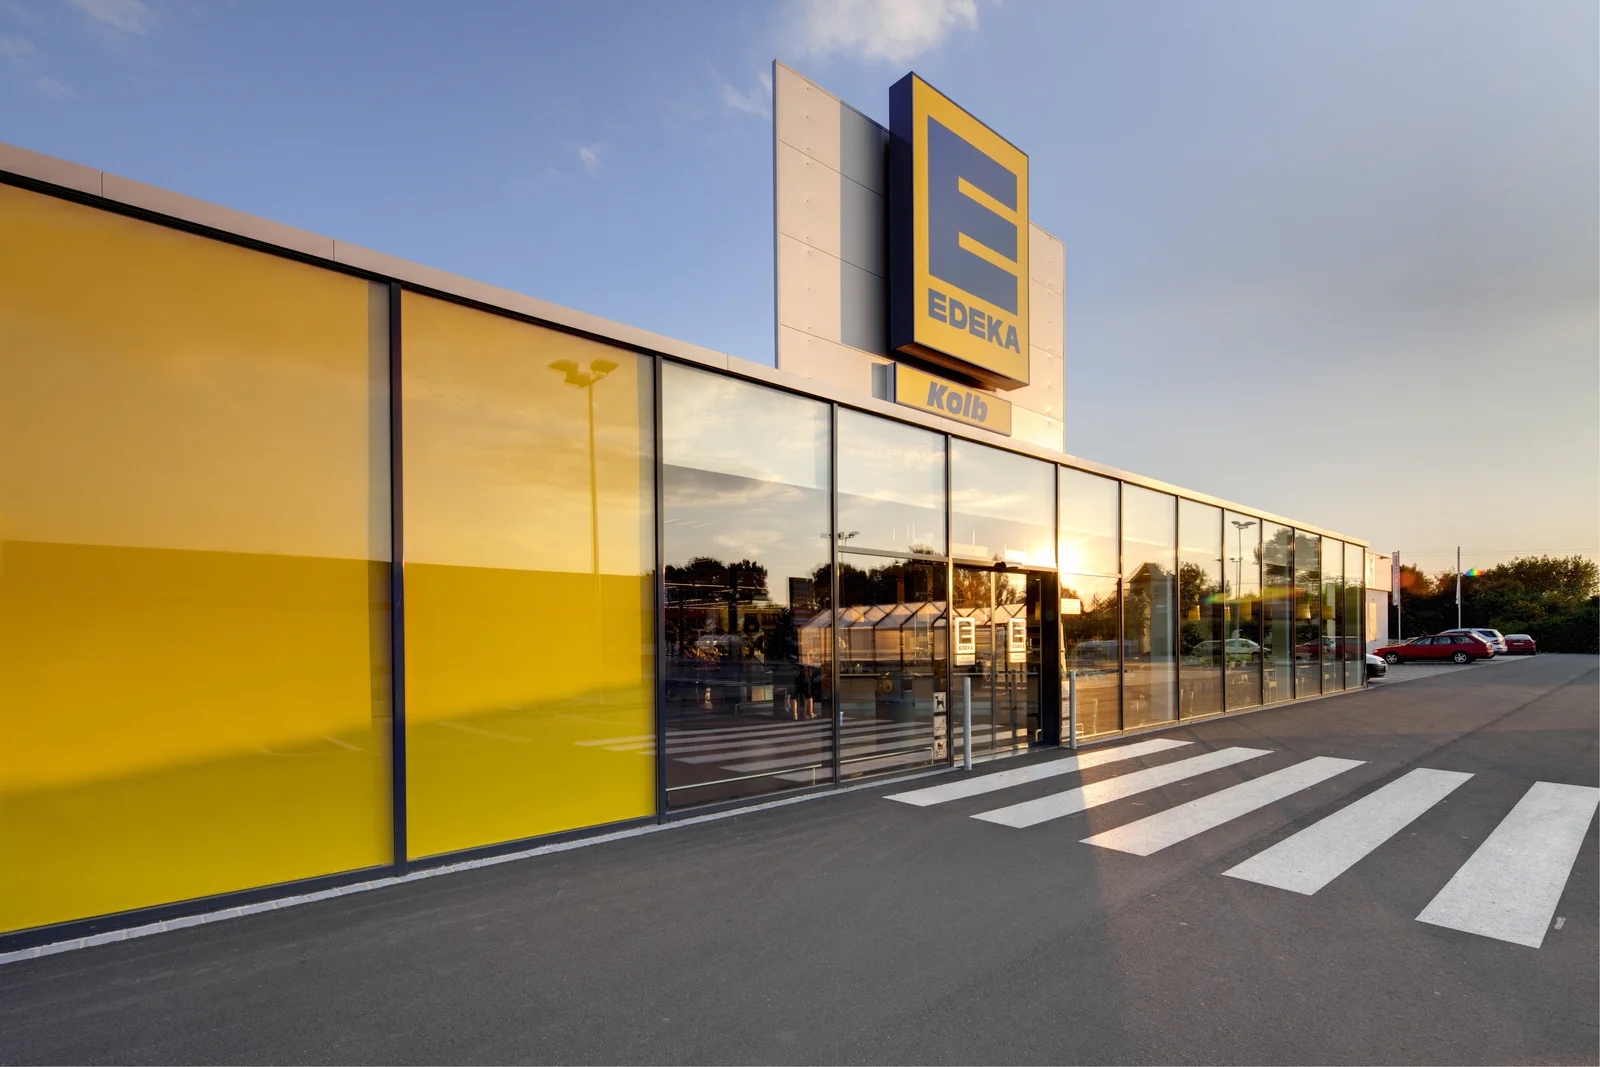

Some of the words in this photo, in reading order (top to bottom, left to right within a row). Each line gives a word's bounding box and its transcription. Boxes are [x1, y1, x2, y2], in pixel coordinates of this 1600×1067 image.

[927, 114, 1018, 316] E
[927, 287, 1021, 355] EDEKA
[926, 381, 988, 423] Kolb
